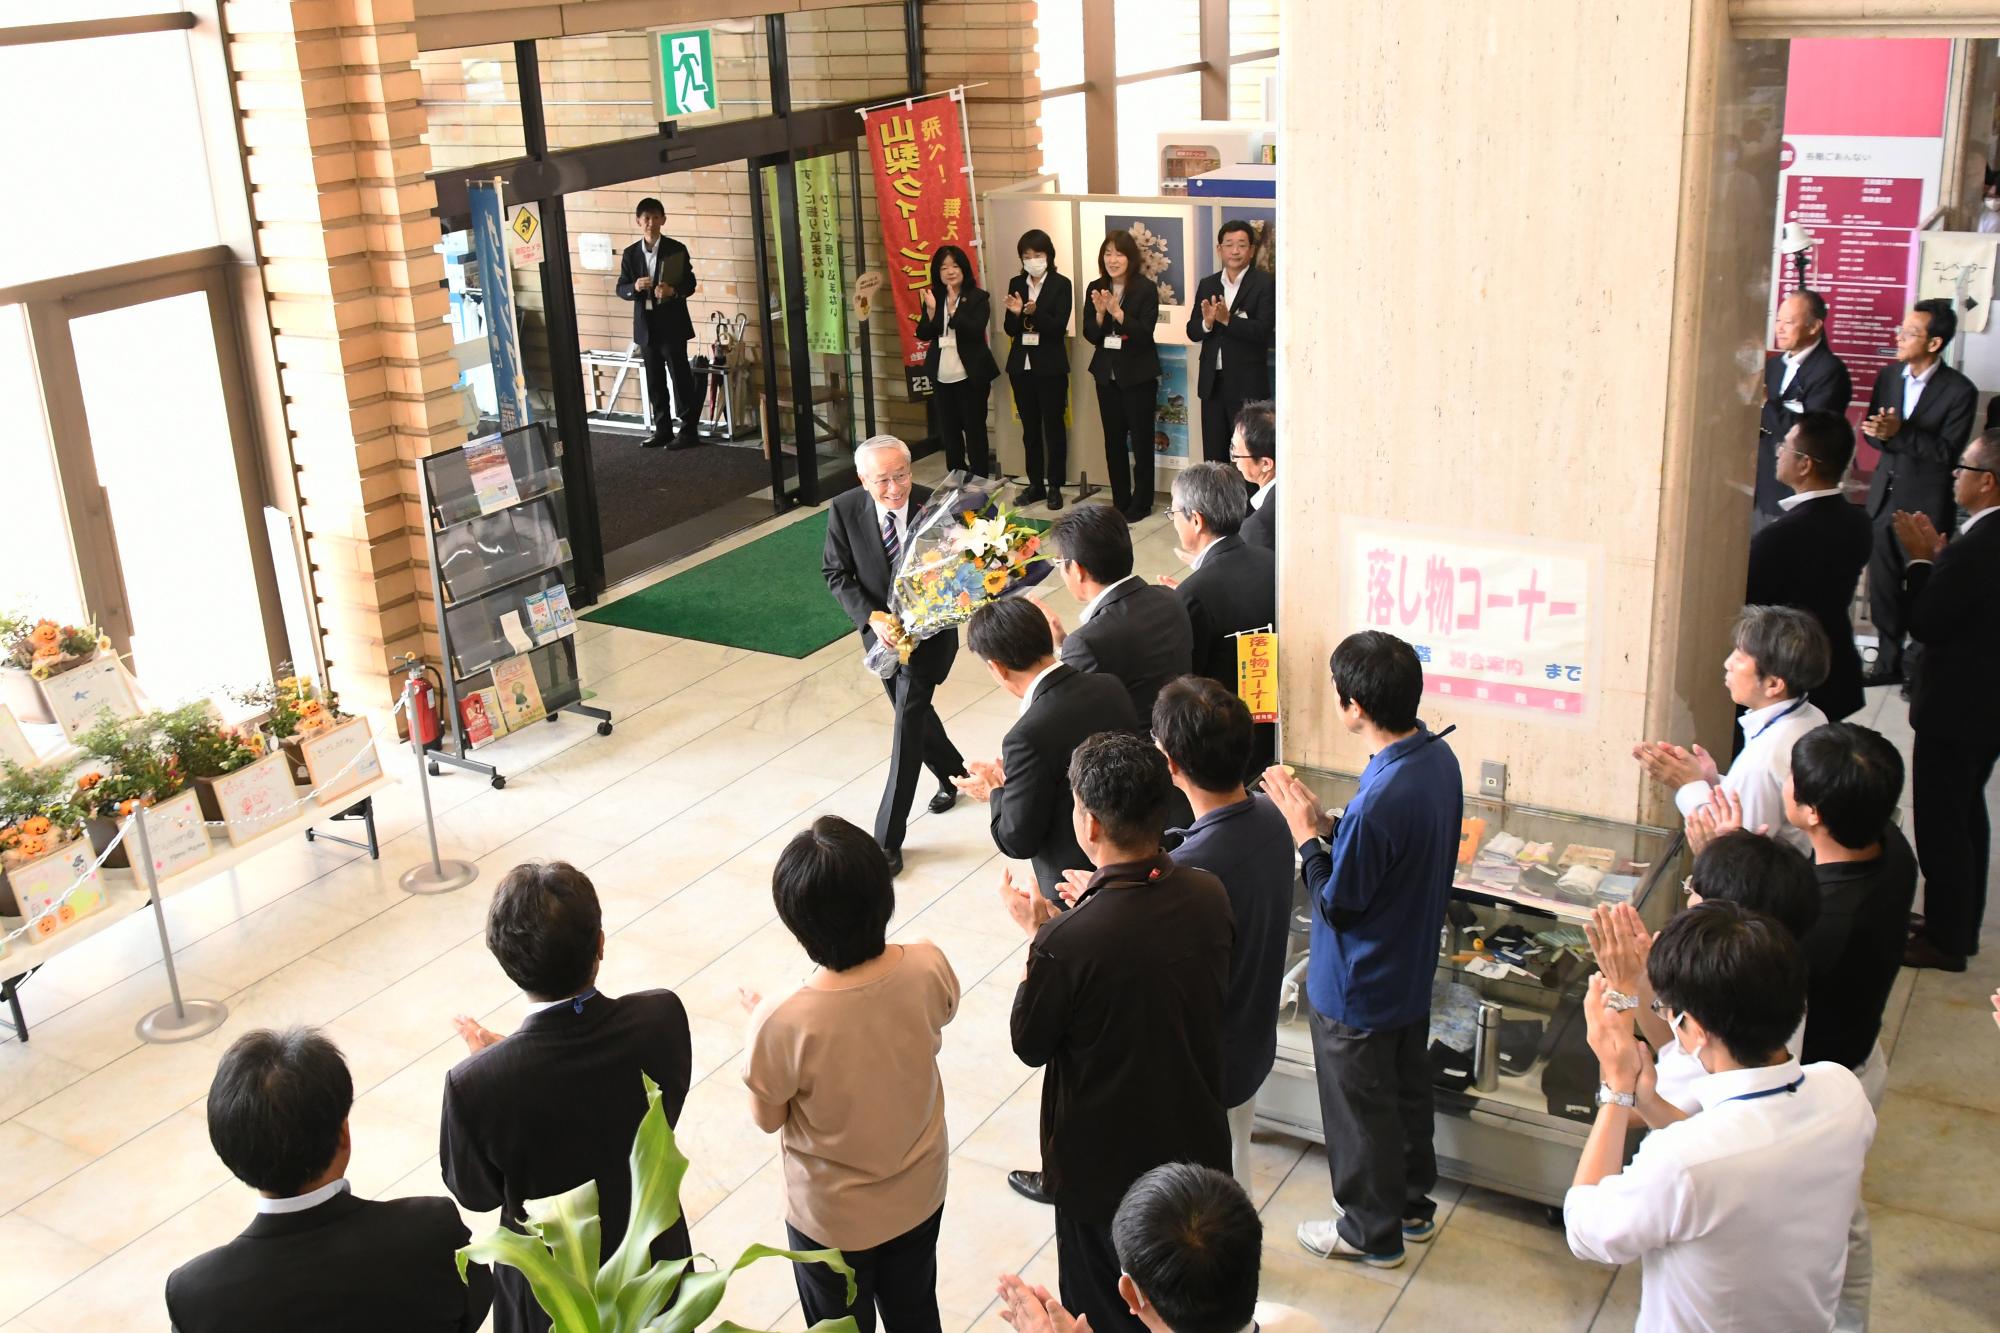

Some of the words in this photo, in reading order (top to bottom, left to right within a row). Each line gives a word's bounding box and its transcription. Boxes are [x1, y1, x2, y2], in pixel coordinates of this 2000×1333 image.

[1366, 547, 1577, 643] 落し物コーナー
[1249, 637, 1271, 709] 落し物コーナー
[1544, 663, 1582, 682] まで
